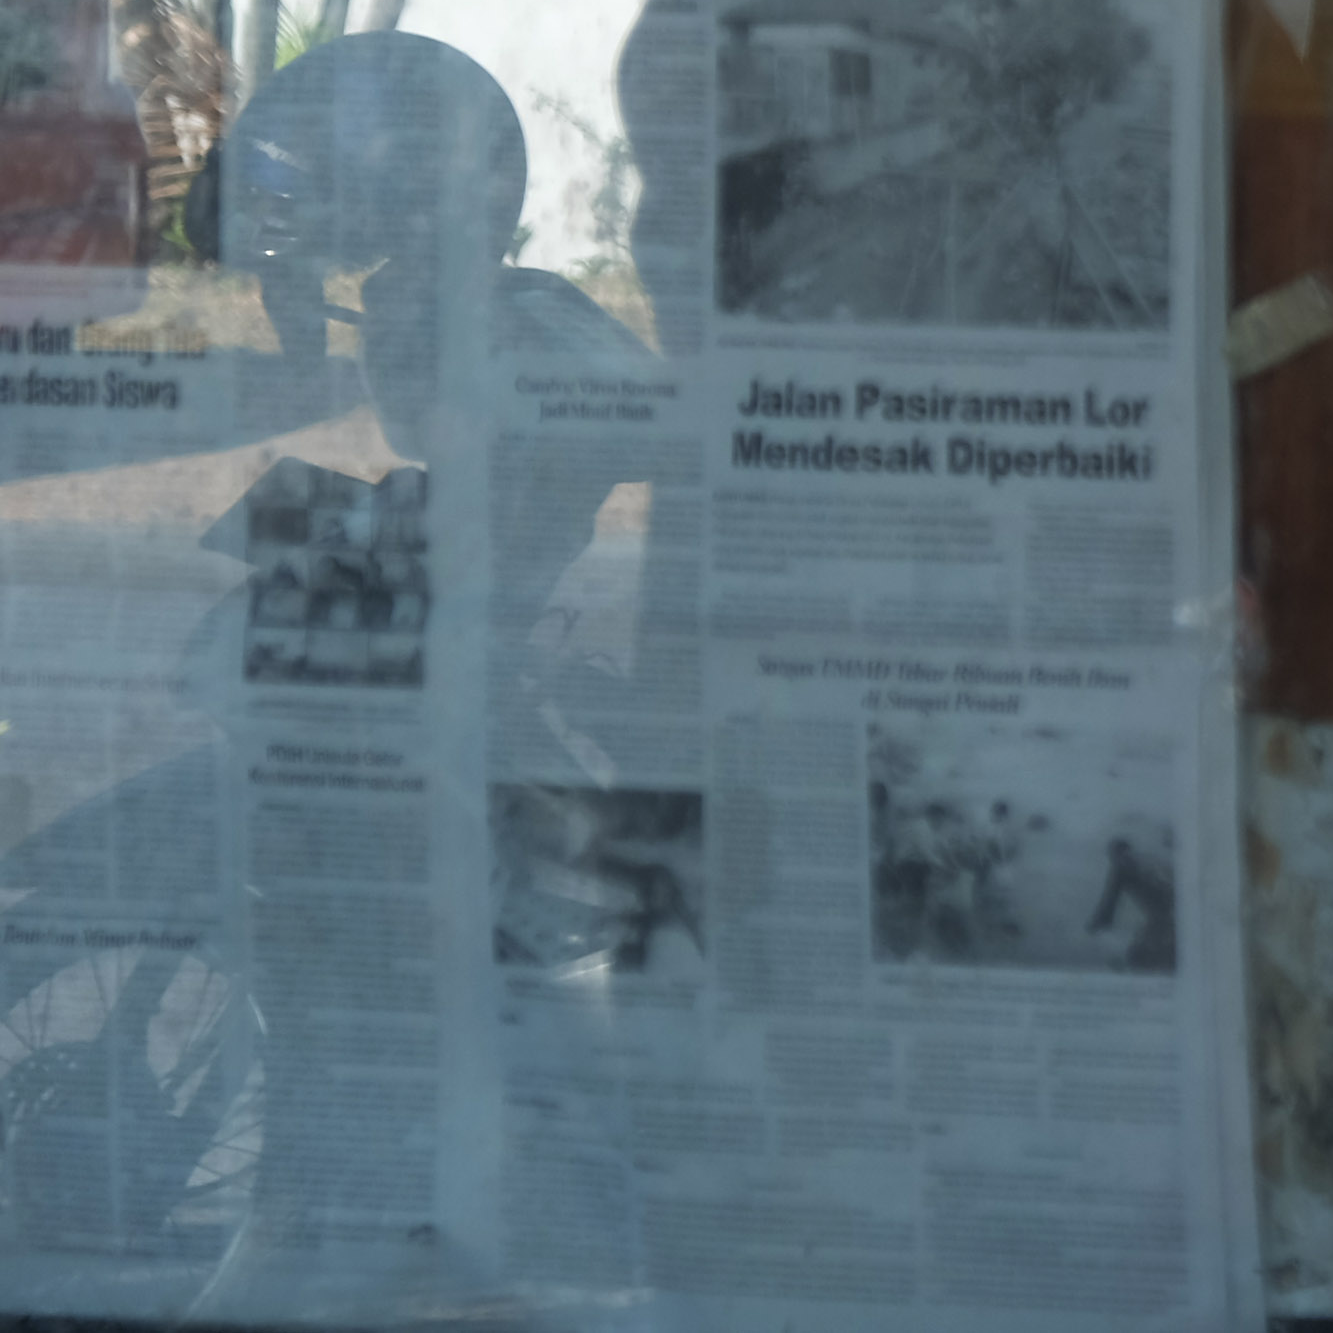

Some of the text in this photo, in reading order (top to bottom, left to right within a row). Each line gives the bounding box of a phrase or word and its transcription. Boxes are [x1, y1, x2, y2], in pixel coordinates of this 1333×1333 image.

[102, 372, 181, 411] Siswa
[737, 375, 1153, 429] Jalan Pasiraman Lor
[729, 424, 1156, 487] Mendesak Diperbaiki
